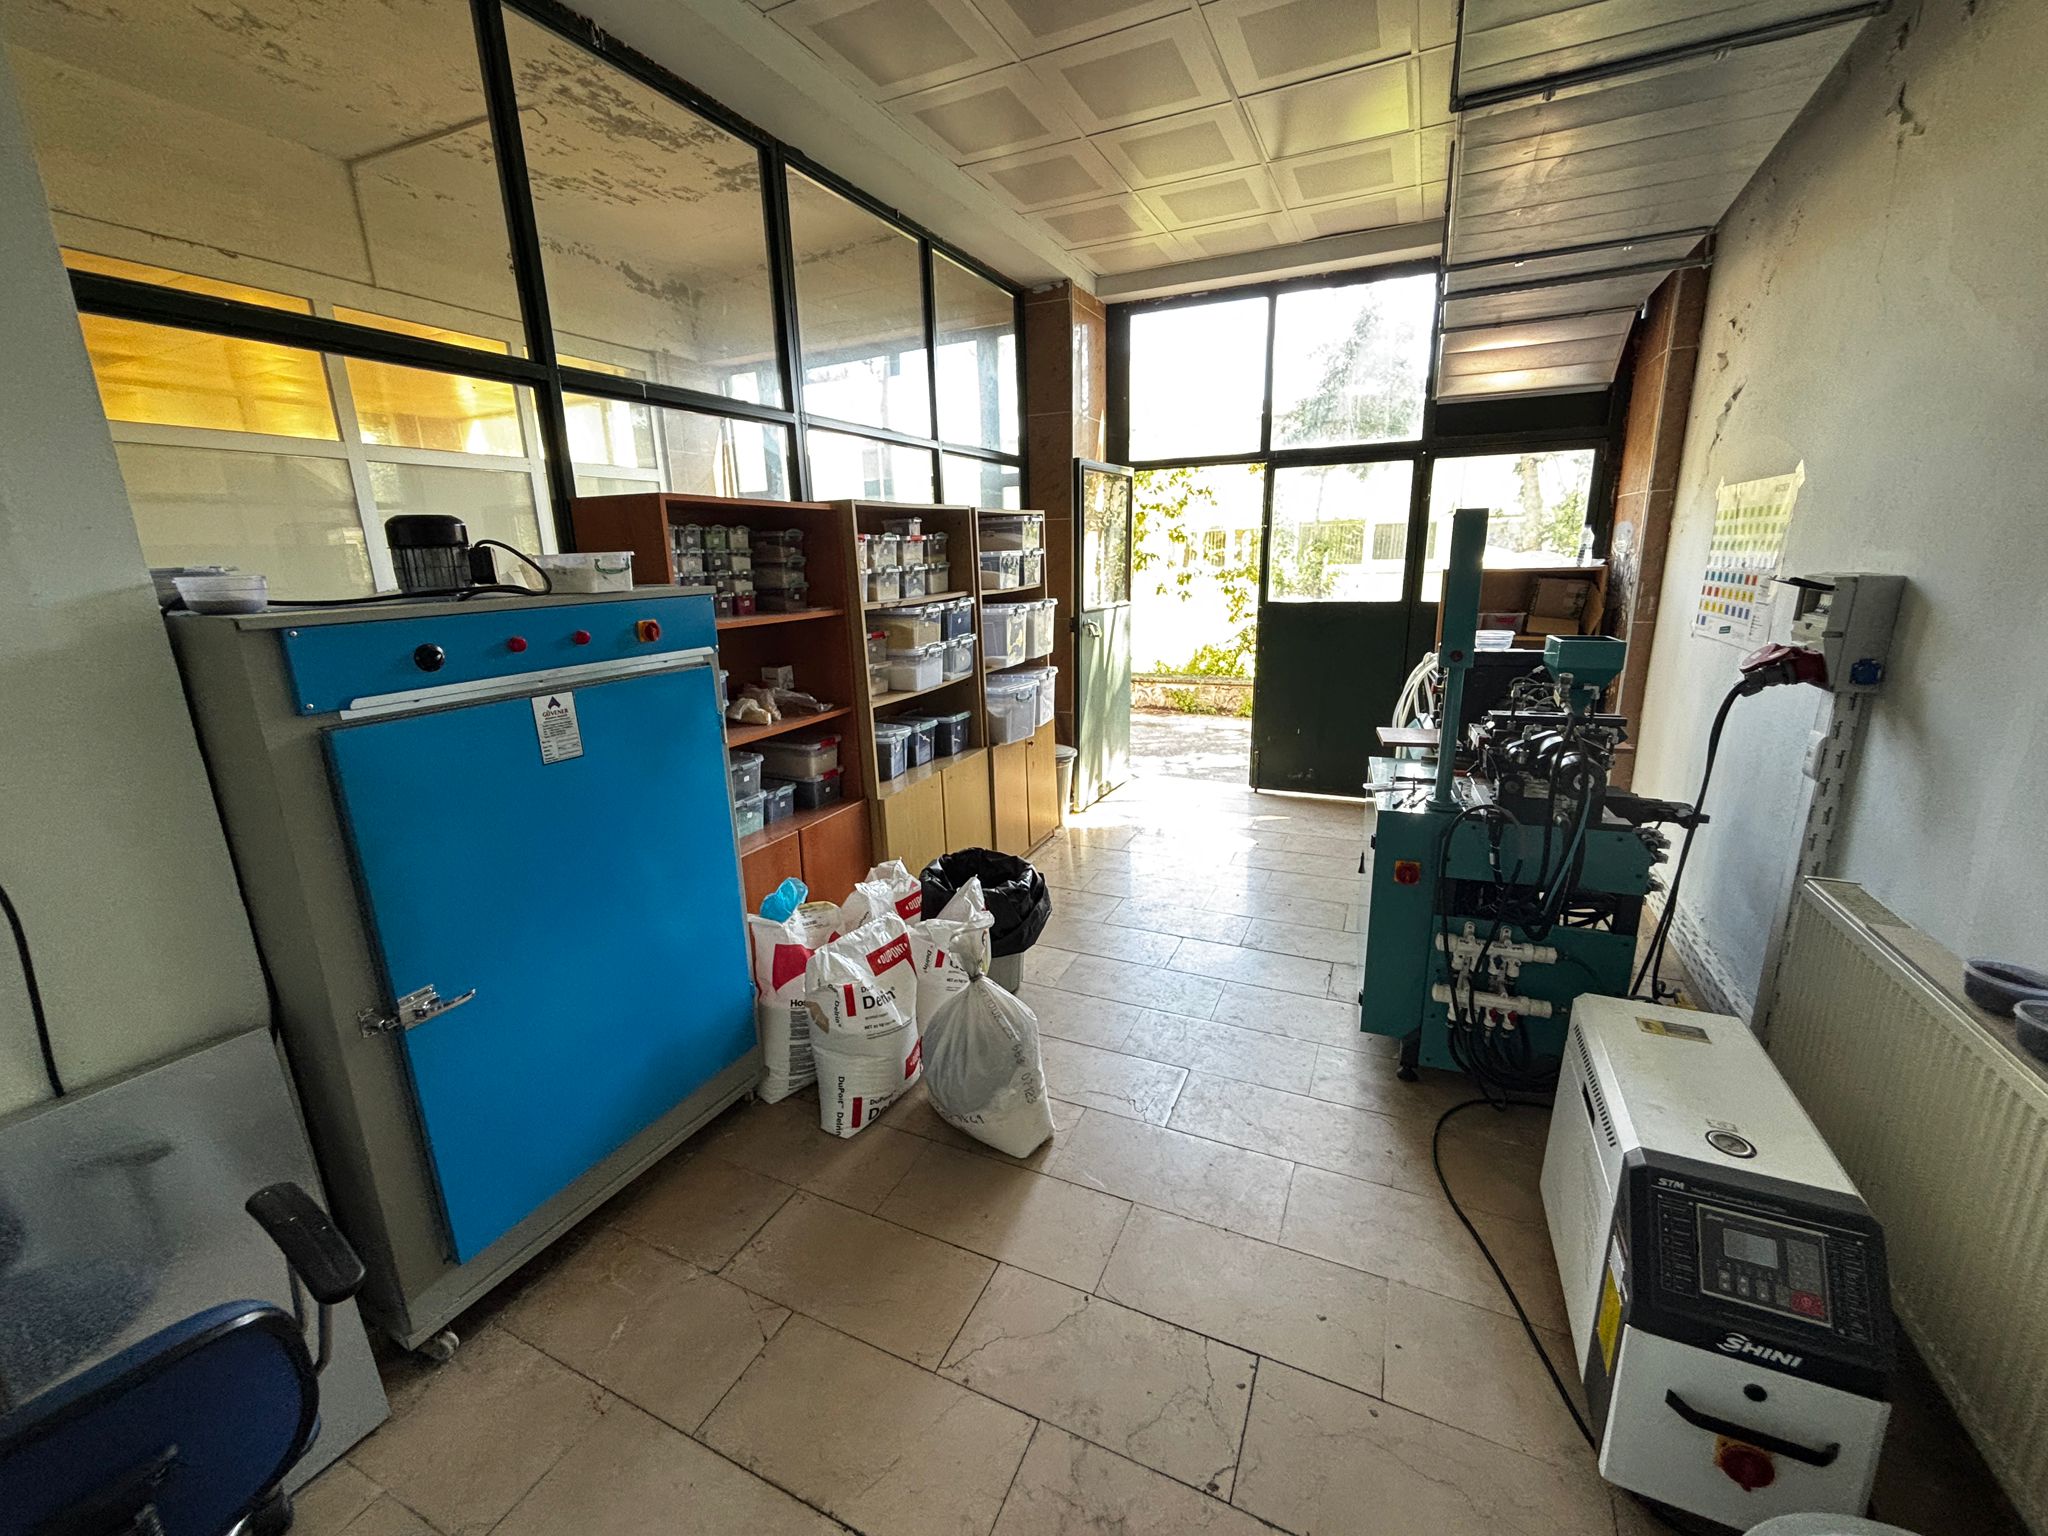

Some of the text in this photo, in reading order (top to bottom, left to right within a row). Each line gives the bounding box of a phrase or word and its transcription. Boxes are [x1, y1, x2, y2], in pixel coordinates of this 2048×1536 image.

[880, 943, 905, 963] DUPONT
[1658, 1177, 1685, 1190] STM
[1716, 1332, 1803, 1368] SHINI
